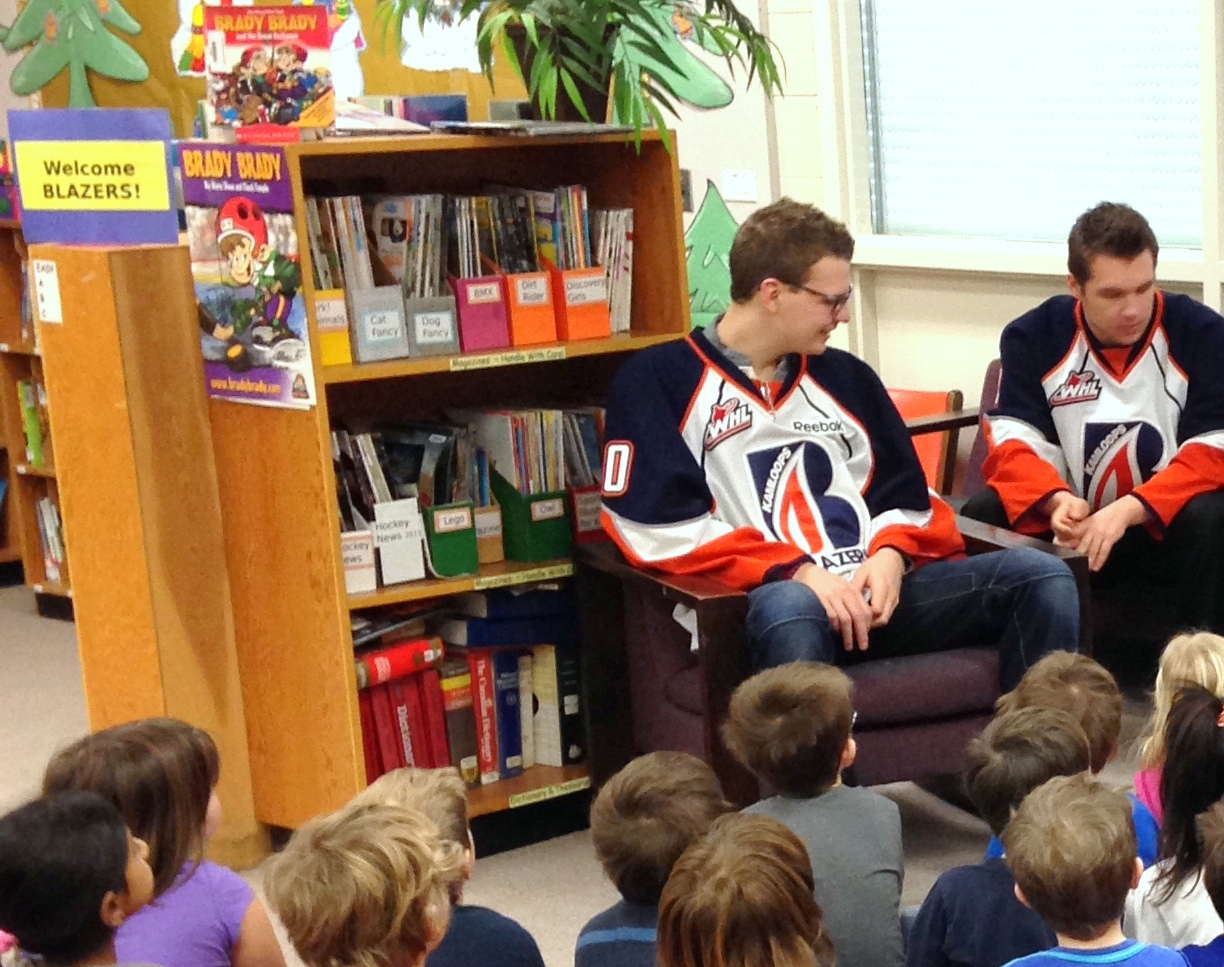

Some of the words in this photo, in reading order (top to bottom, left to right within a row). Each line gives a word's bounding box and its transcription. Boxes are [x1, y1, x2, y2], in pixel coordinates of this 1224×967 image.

[213, 15, 264, 32] BRADY
[267, 14, 318, 31] BRADY
[43, 160, 135, 176] Welcome
[182, 149, 232, 178] BRADY
[236, 152, 281, 181] BRADY
[42, 184, 141, 200] BLAZERS!
[370, 315, 387, 325] Cat
[421, 317, 441, 327] Dog
[1056, 380, 1102, 399] WHL
[707, 404, 752, 438] WHL
[793, 421, 845, 432] Reebok
[762, 446, 792, 513] KAMLOOPS
[375, 520, 409, 530] Hockey
[443, 515, 465, 526] Lego
[377, 534, 402, 543] News
[343, 543, 369, 551] ockey
[343, 555, 362, 564] ews
